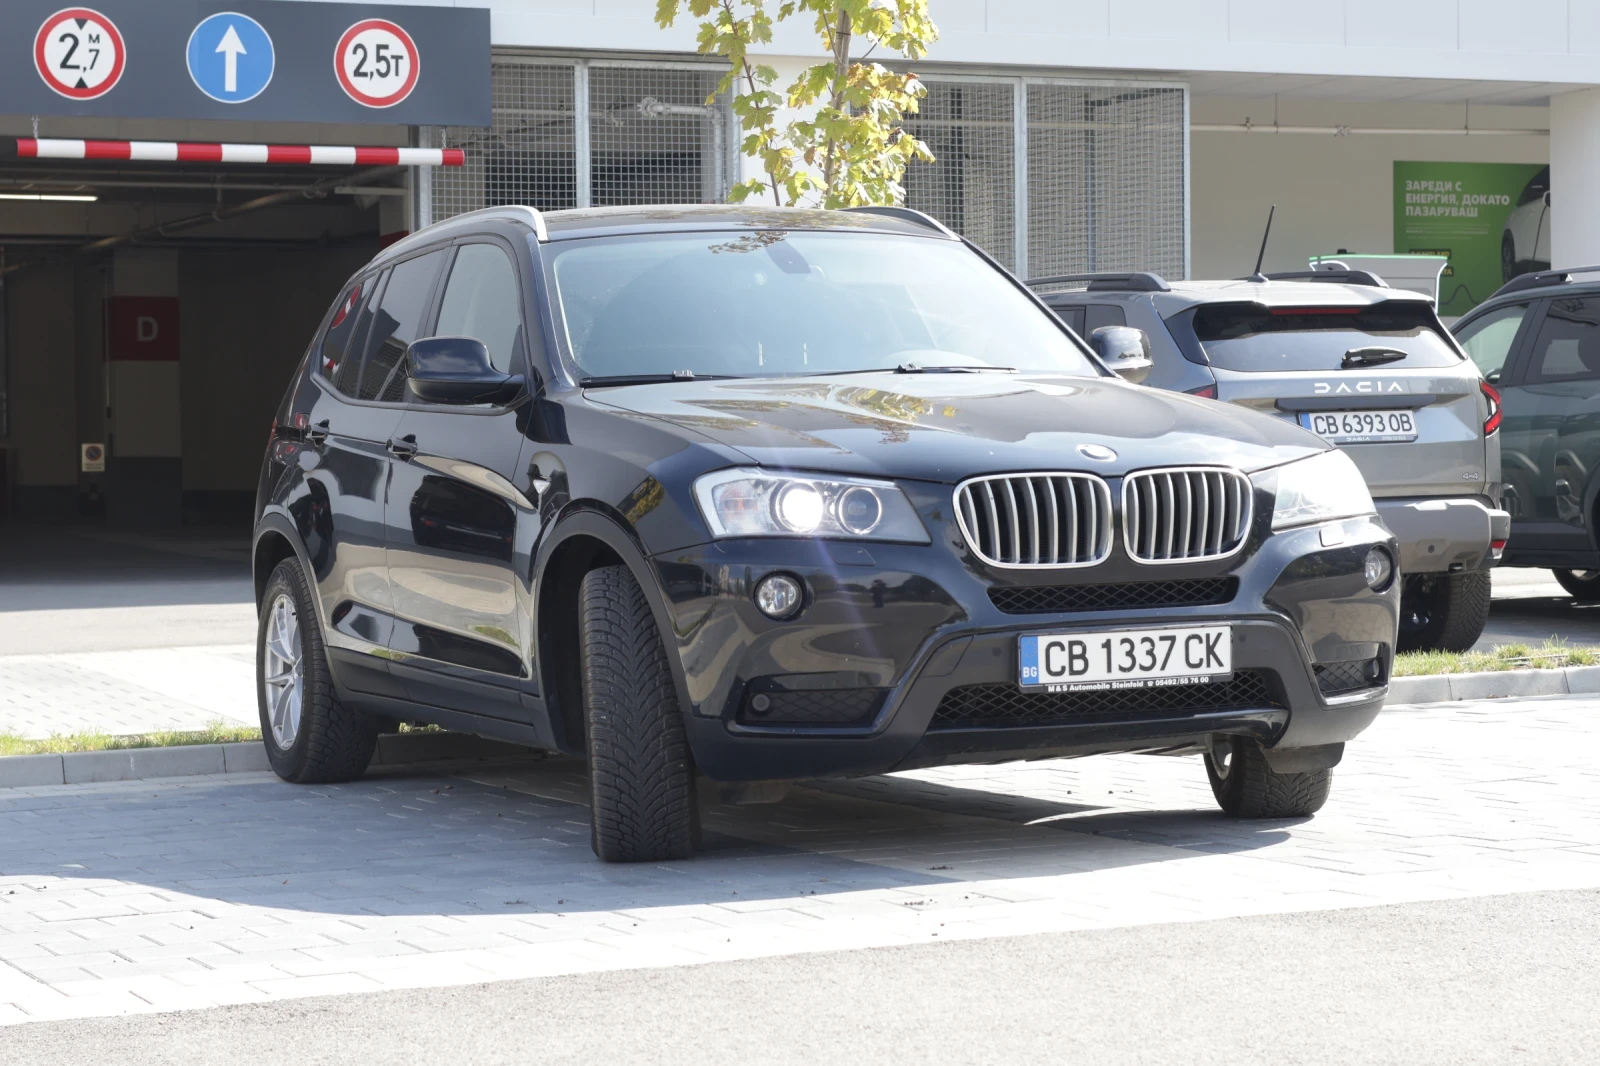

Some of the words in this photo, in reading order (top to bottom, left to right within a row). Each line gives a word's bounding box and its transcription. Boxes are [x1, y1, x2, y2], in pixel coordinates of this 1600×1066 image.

[1405, 180, 1453, 192] ЗАРЕДИ
[1455, 181, 1462, 191] С
[1405, 193, 1459, 205] ЕНЕРГИЯ,
[1461, 194, 1510, 206] ДОКАТО
[1405, 206, 1478, 217] ПАЗАРУВАШ
[137, 316, 158, 341] D
[1314, 381, 1403, 393] DACIA
[1314, 415, 1339, 435] CB
[1343, 413, 1386, 434] 6393
[1045, 640, 1089, 677] CB
[1101, 635, 1177, 674] 1337
[1184, 632, 1224, 669] CK
[1023, 666, 1037, 678] BG
[1069, 682, 1110, 691] Automobile
[1112, 681, 1144, 689] Steinfeld
